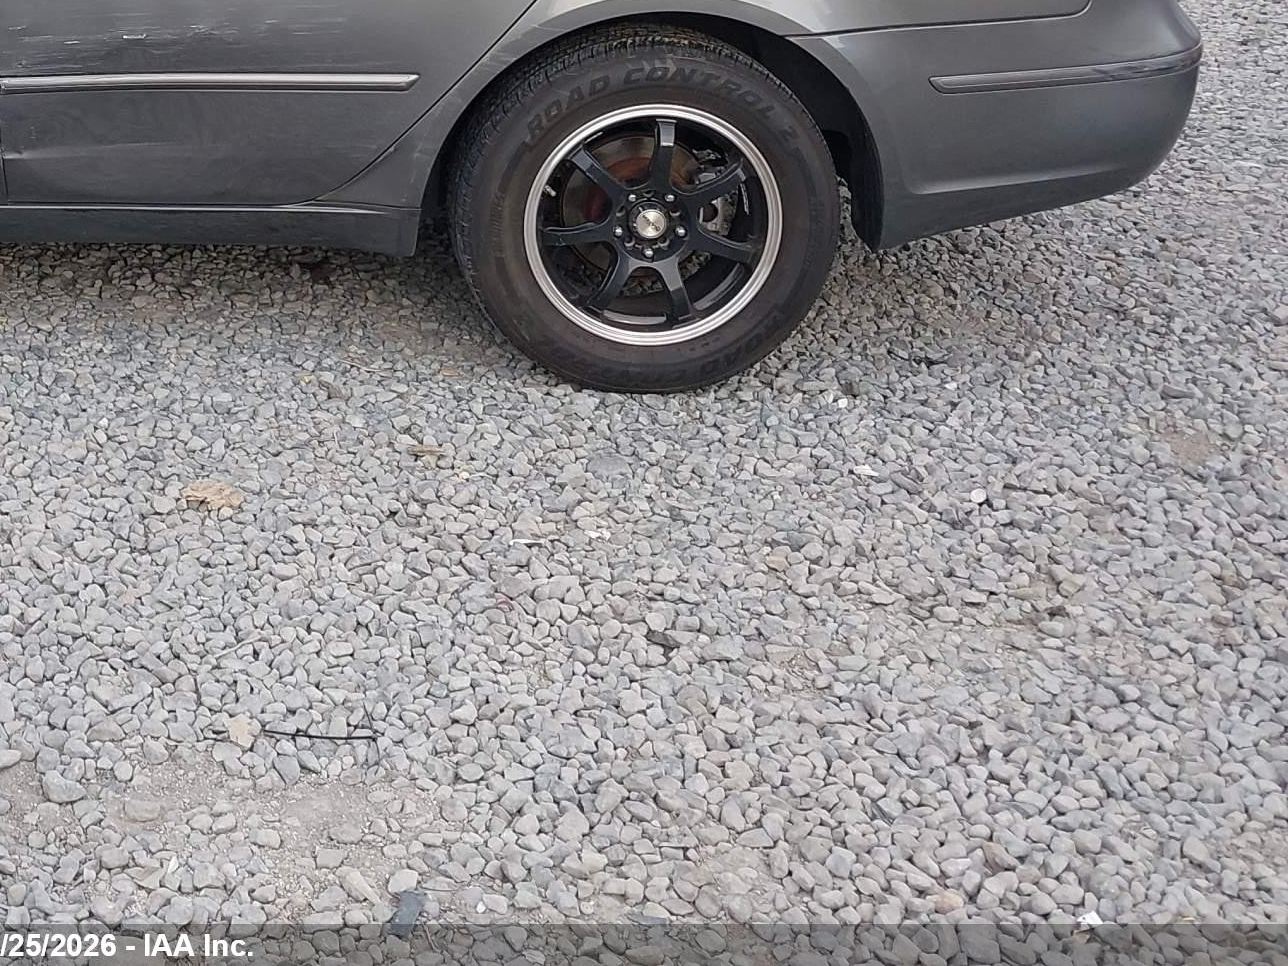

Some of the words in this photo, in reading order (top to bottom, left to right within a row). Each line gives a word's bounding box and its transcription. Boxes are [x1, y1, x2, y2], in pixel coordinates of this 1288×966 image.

[527, 75, 611, 136] ROAD
[623, 66, 775, 116] CONTROL
[781, 126, 798, 143] 2
